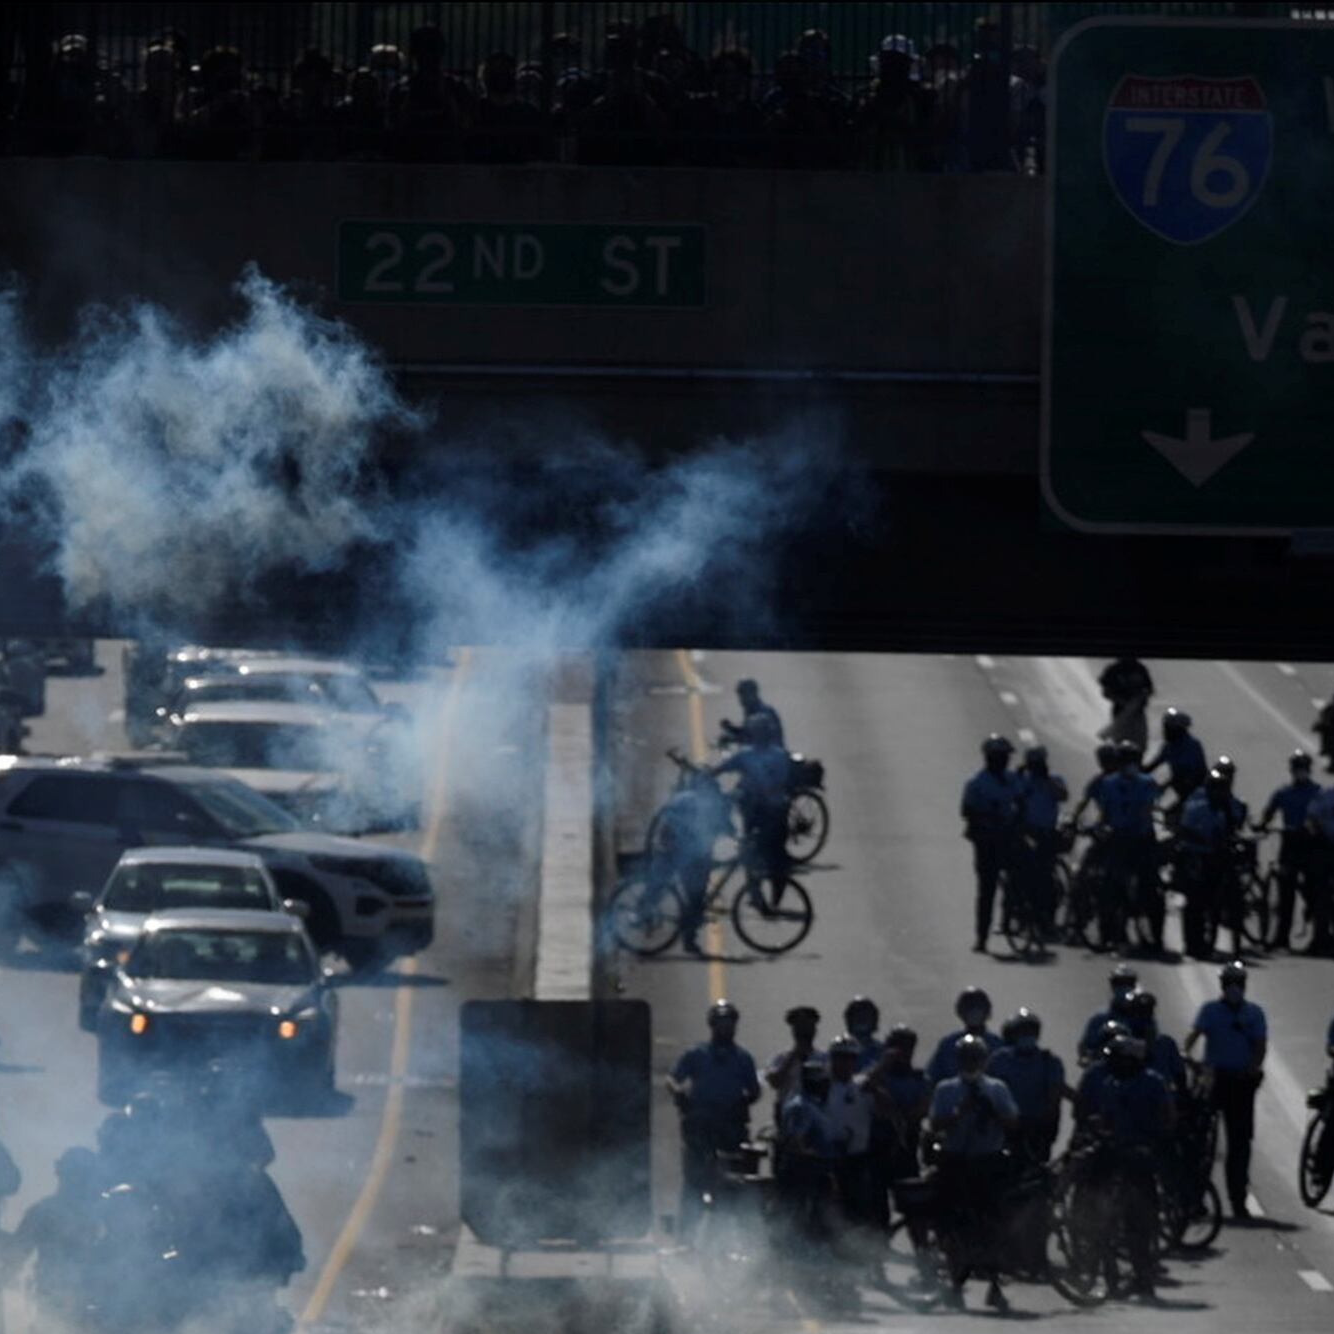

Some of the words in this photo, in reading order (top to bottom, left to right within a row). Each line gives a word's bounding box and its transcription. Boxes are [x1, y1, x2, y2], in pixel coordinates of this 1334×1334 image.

[1124, 117, 1250, 208] 76
[363, 231, 545, 293] 22ND
[600, 234, 682, 297] ST
